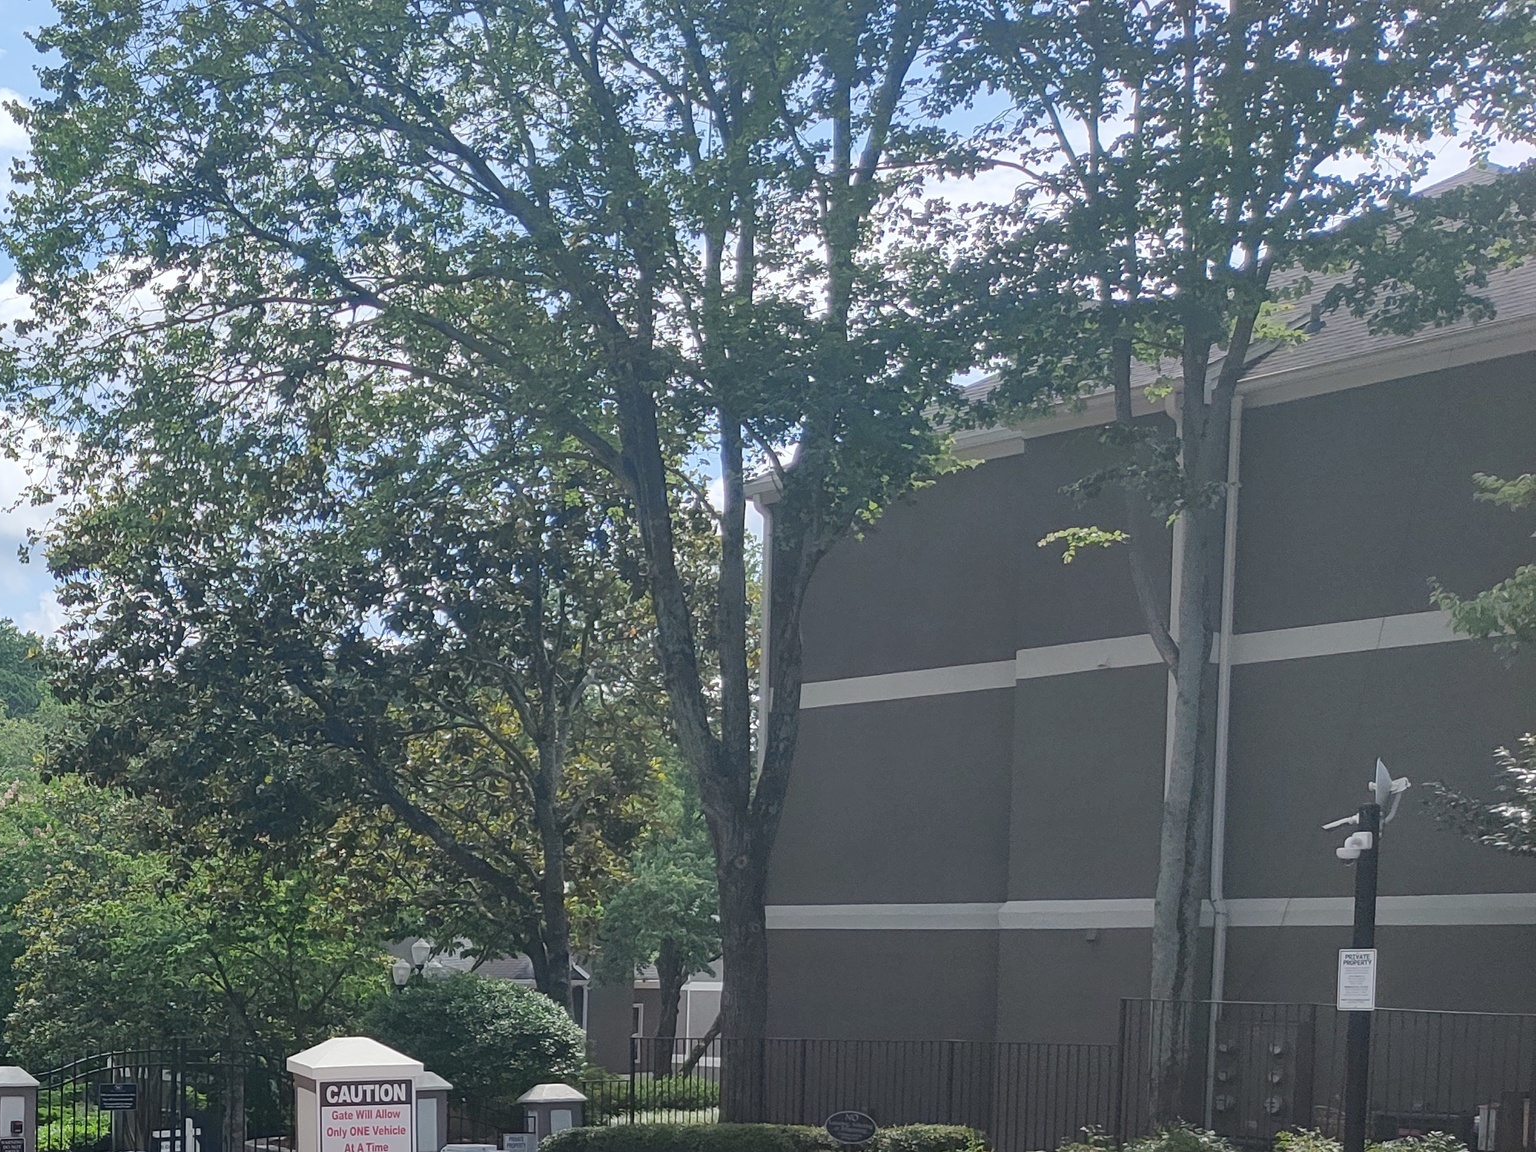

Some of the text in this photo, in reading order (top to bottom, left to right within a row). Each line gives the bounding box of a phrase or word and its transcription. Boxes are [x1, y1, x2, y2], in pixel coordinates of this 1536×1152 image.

[326, 1083, 406, 1104] CAUTION
[331, 1109, 401, 1120] Gate Will Allow
[845, 1113, 859, 1121] NO
[326, 1125, 406, 1139] Only ONE Vehicle
[344, 1142, 389, 1152] At A Time
